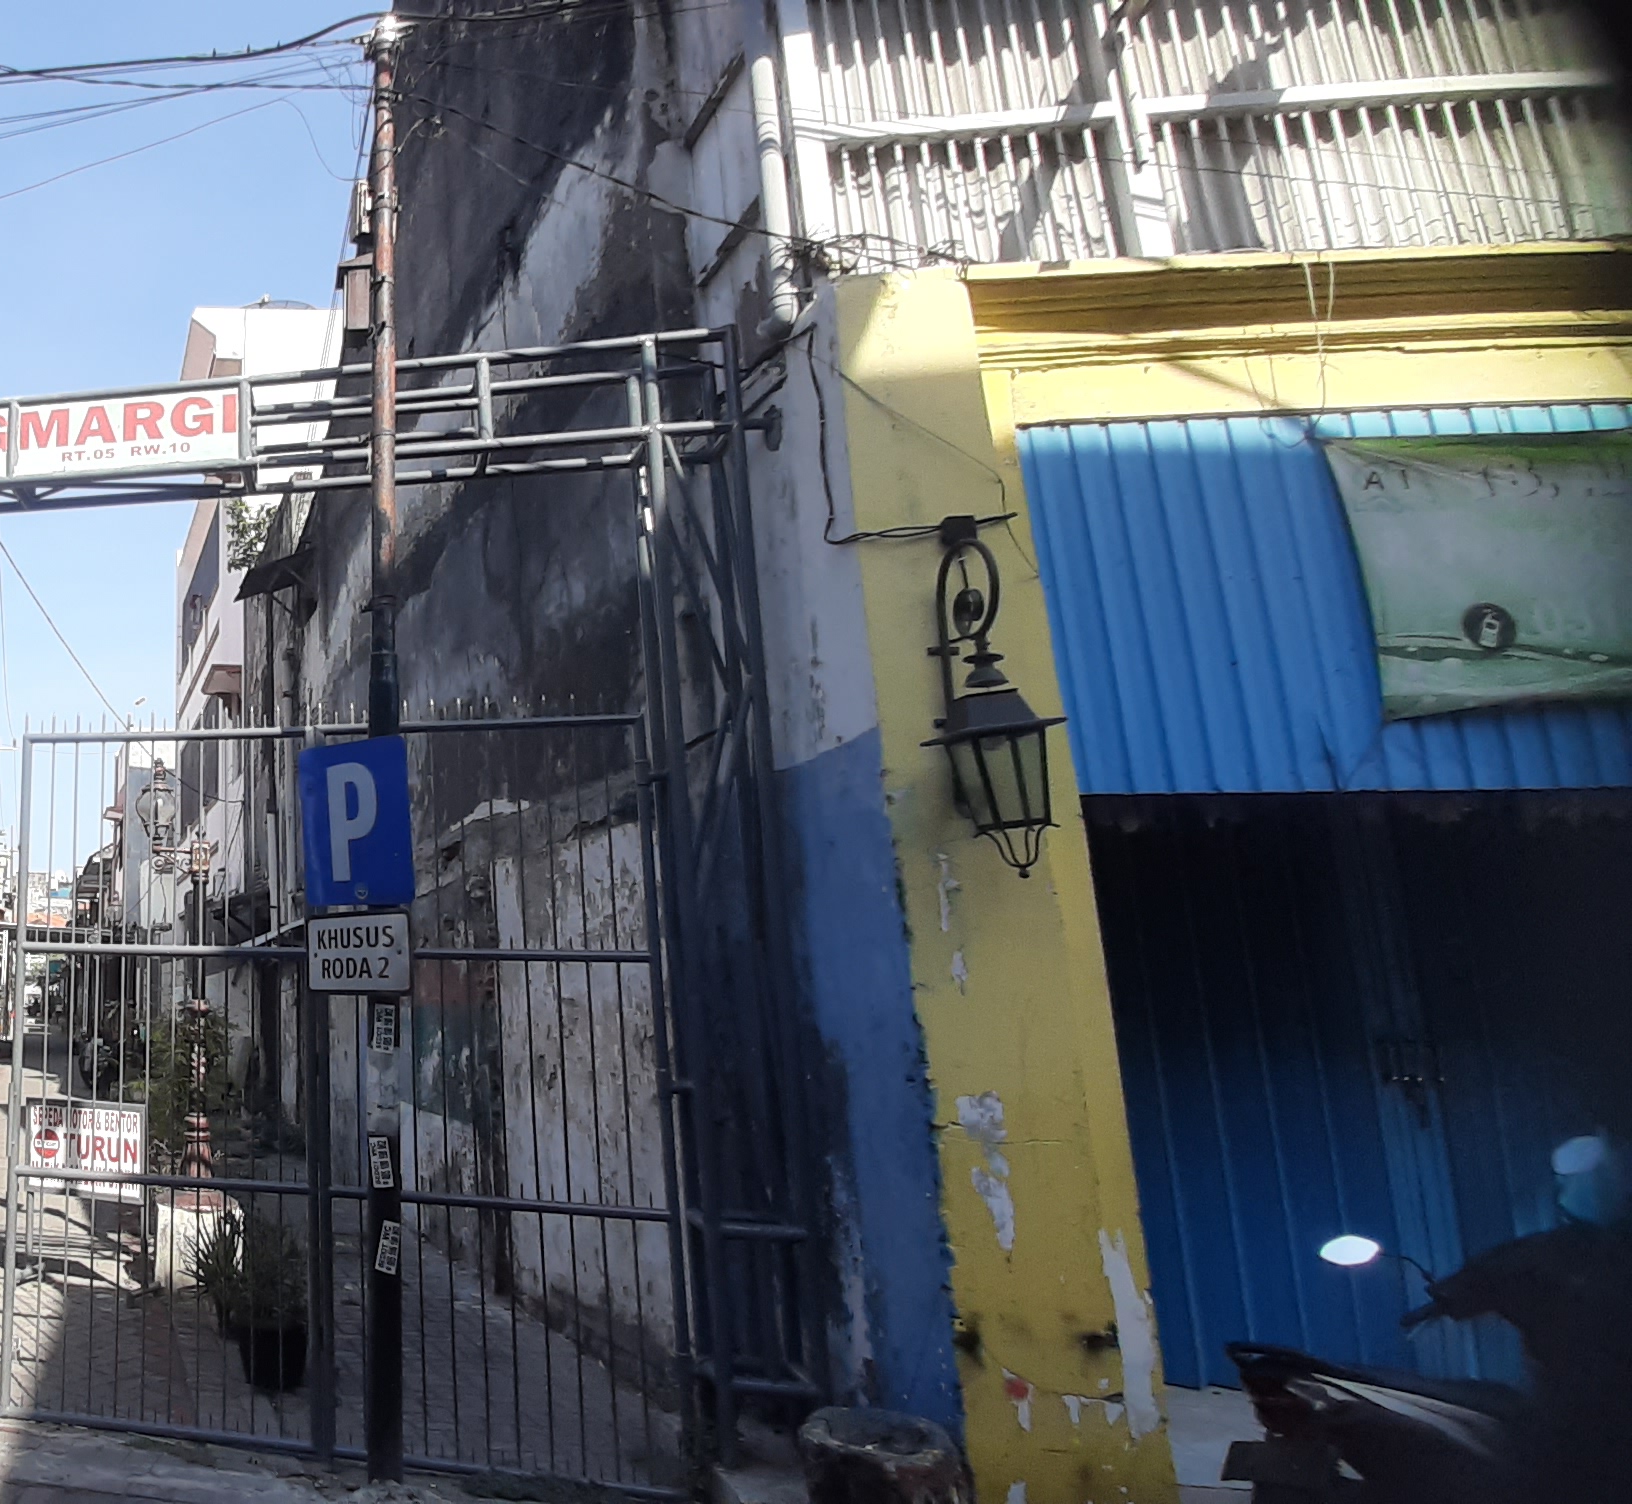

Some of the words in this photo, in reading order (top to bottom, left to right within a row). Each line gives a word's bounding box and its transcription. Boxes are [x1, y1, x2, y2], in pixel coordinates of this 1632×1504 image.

[19, 394, 237, 450] MARGI
[61, 448, 115, 462] RT.05
[130, 442, 191, 456] RW.10
[326, 762, 377, 882] P
[317, 925, 395, 950] KHUSUS
[322, 958, 373, 979] RODA
[377, 956, 390, 978] 2
[63, 1133, 138, 1164] TURUN
